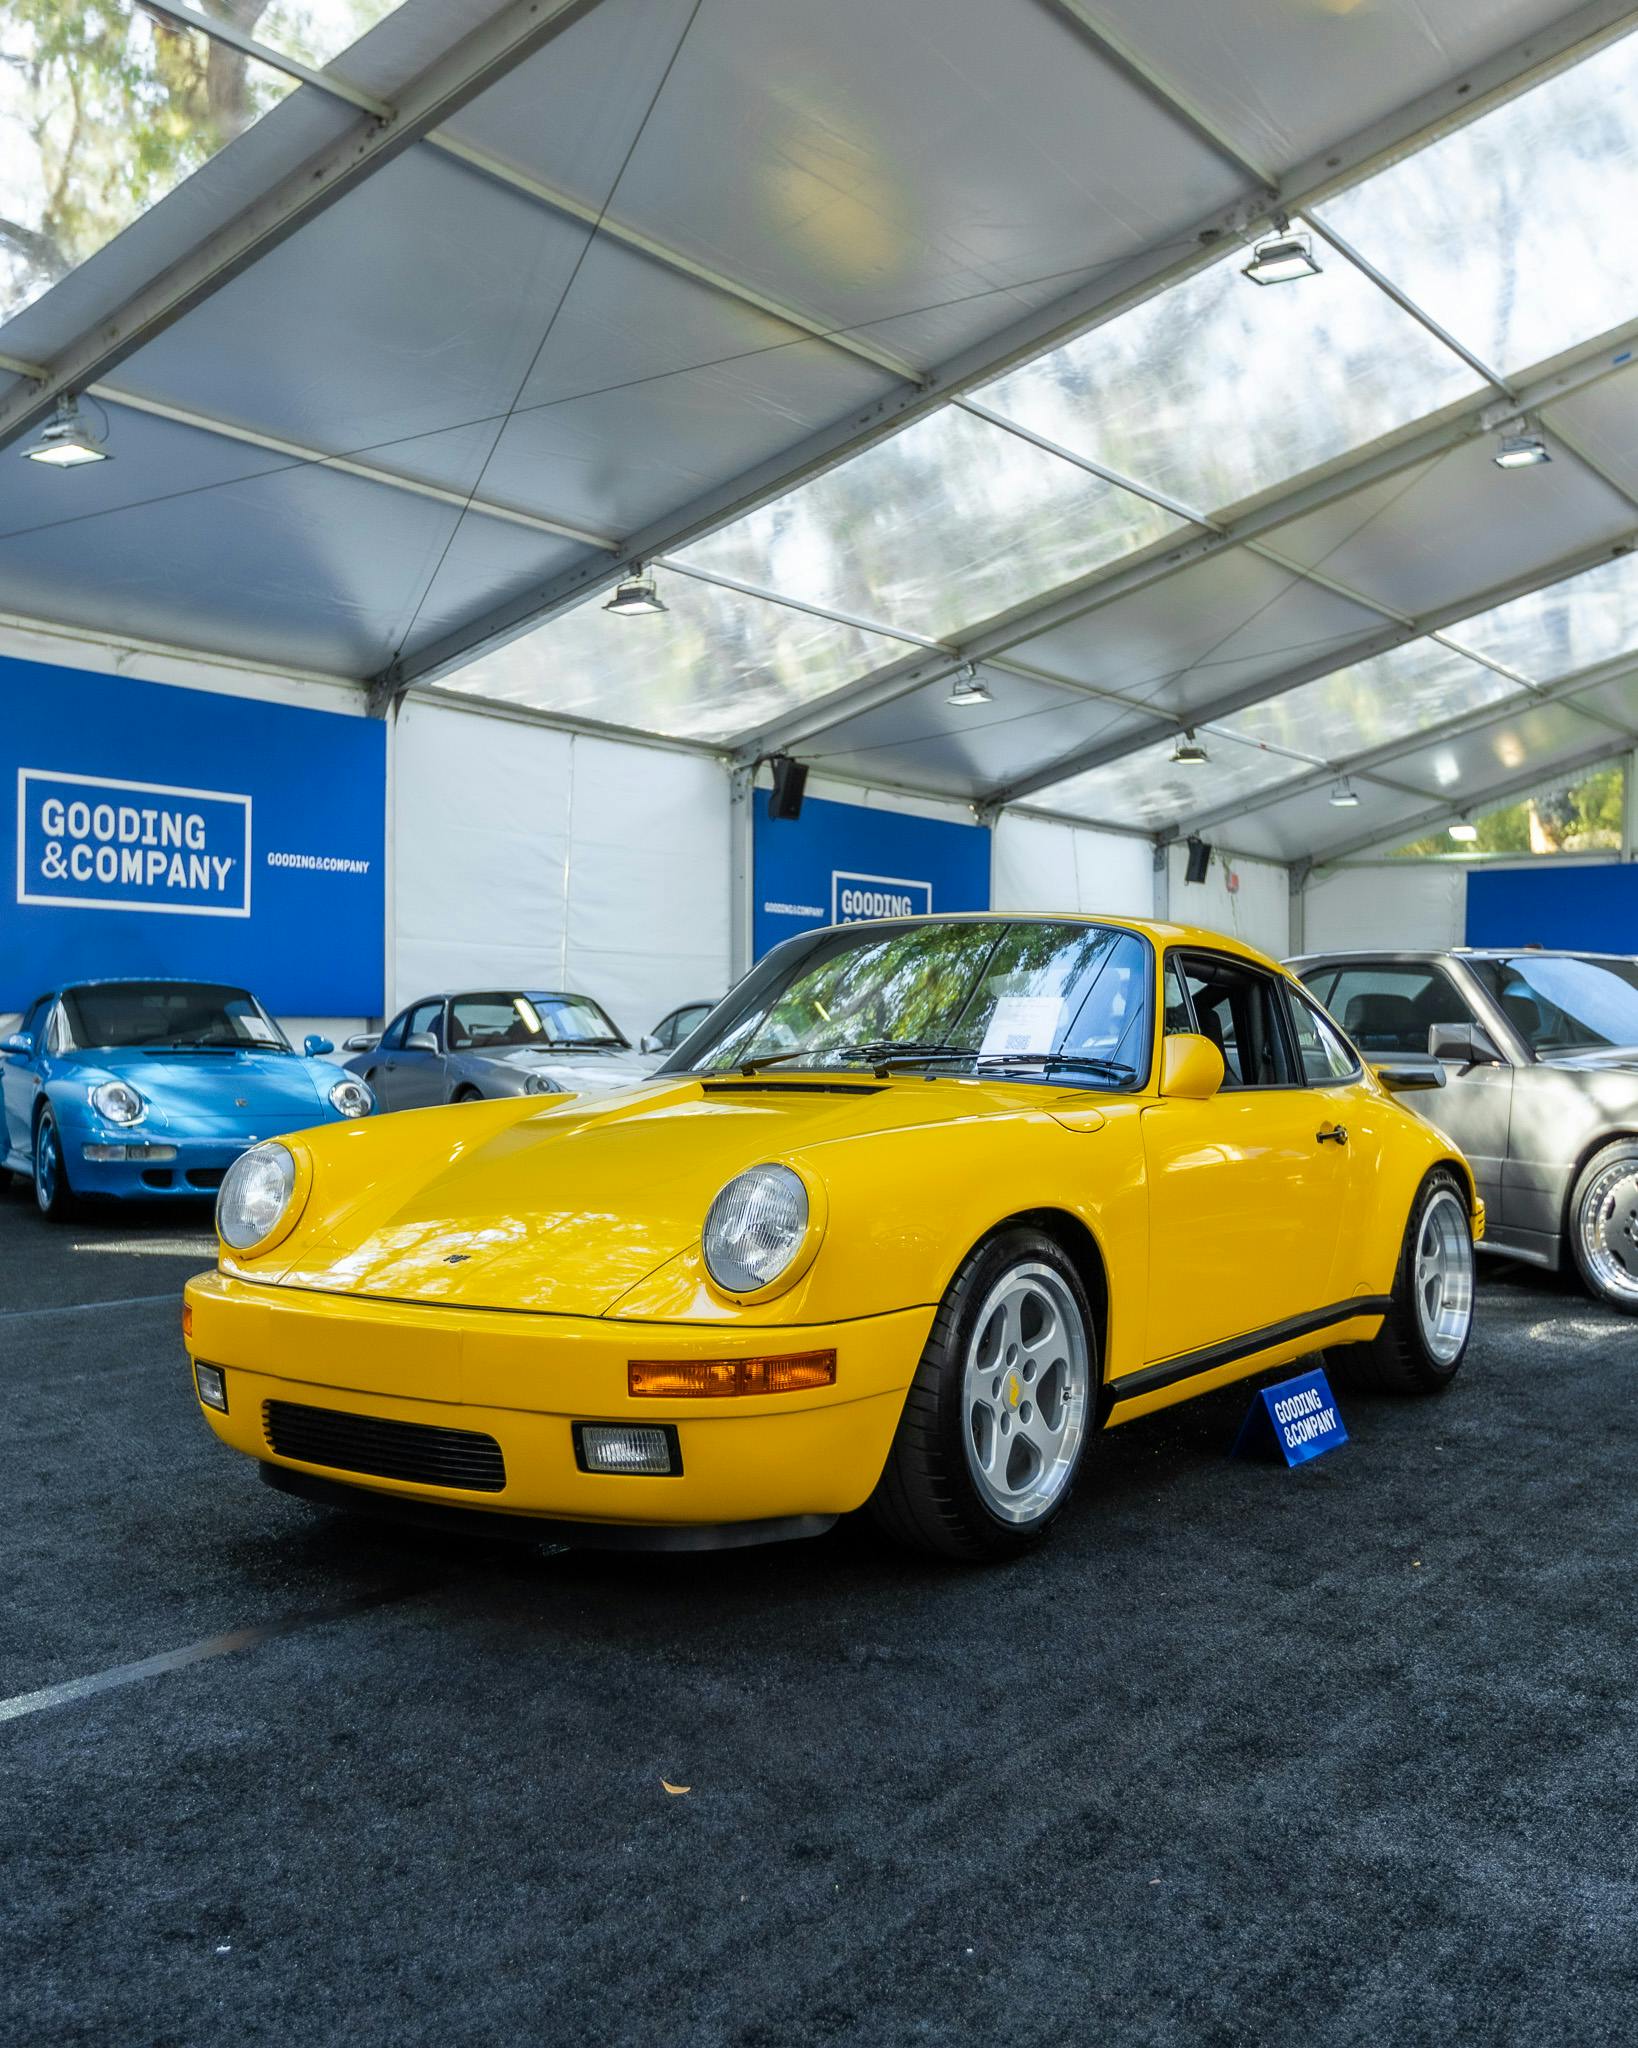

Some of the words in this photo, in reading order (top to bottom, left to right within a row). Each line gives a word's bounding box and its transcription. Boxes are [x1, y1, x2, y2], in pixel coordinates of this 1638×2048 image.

[41, 799, 206, 850] GOODING
[41, 842, 232, 891] &COMPANY
[267, 852, 370, 873] GOODING&COMPANY
[841, 889, 912, 917] GOODING
[1274, 1388, 1323, 1424] GOODING
[1283, 1407, 1337, 1448] &COMPANY
